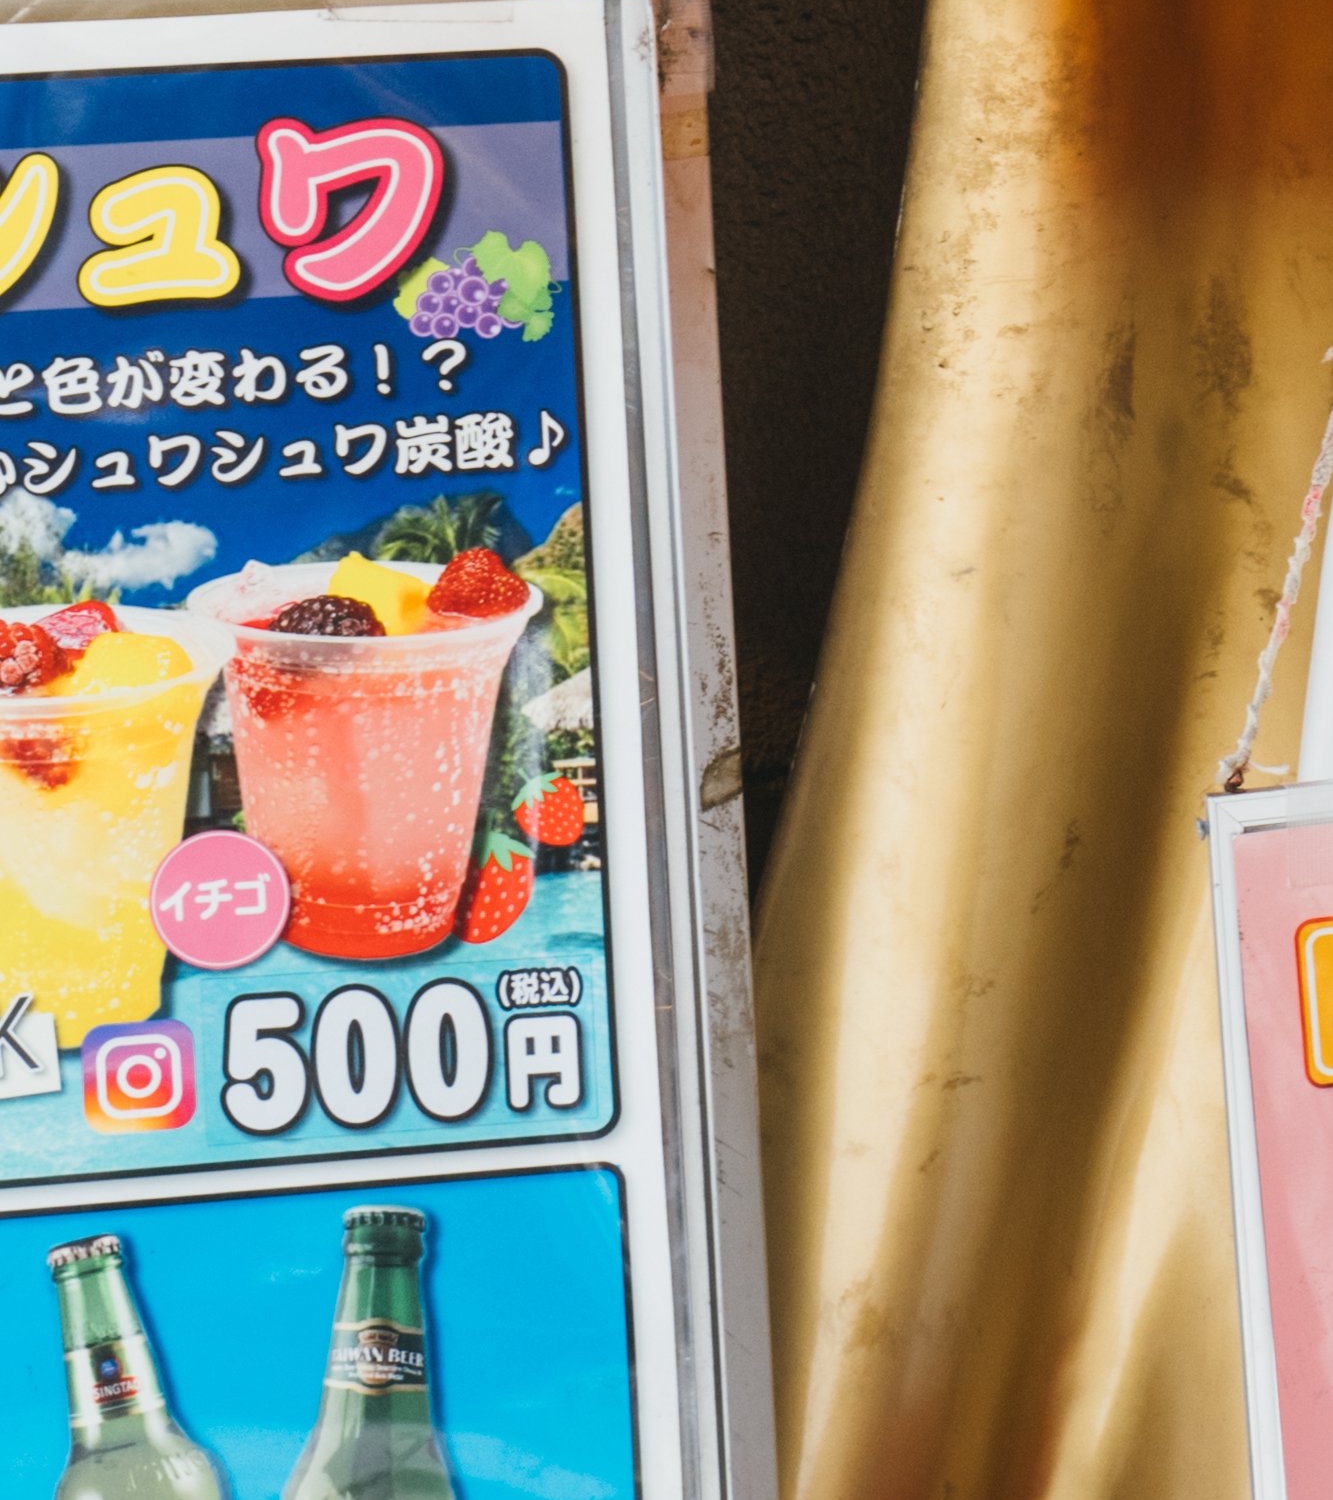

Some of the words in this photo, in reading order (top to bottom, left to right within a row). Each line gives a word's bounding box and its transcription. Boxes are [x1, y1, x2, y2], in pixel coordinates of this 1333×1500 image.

[159, 873, 271, 923] イチゴ
[499, 968, 582, 1006] (税込)
[223, 979, 583, 1133] 500円
